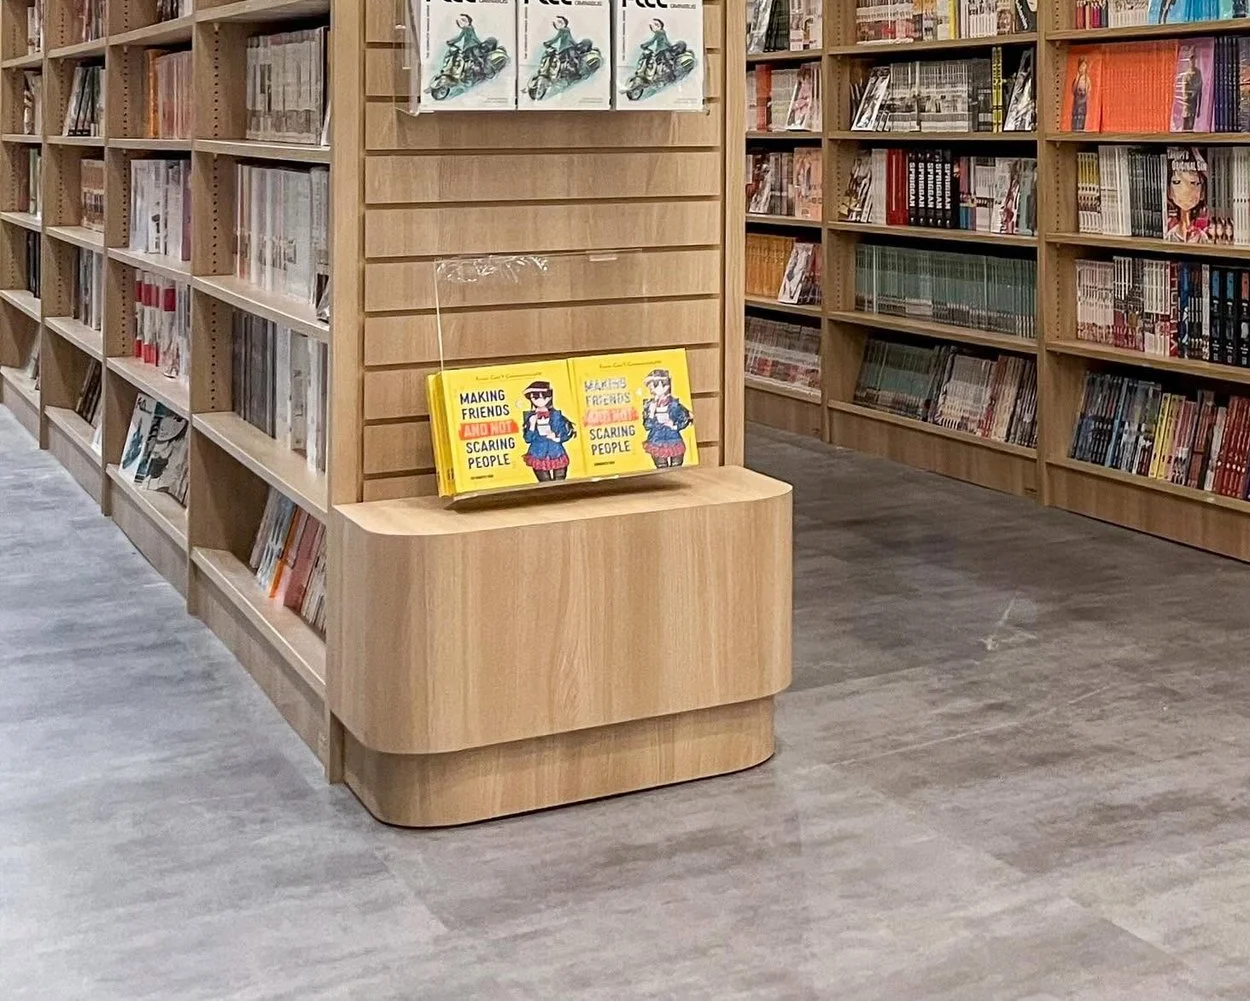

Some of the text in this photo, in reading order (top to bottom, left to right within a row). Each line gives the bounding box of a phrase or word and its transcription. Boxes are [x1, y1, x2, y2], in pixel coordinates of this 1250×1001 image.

[459, 389, 505, 405] MAKING
[461, 404, 510, 420] FRIENDS
[463, 421, 513, 438] AND NOT
[589, 425, 636, 441] SCARING
[466, 437, 516, 454] SCARING
[592, 440, 631, 456] PEOPLE
[468, 453, 511, 470] PEOPLE
